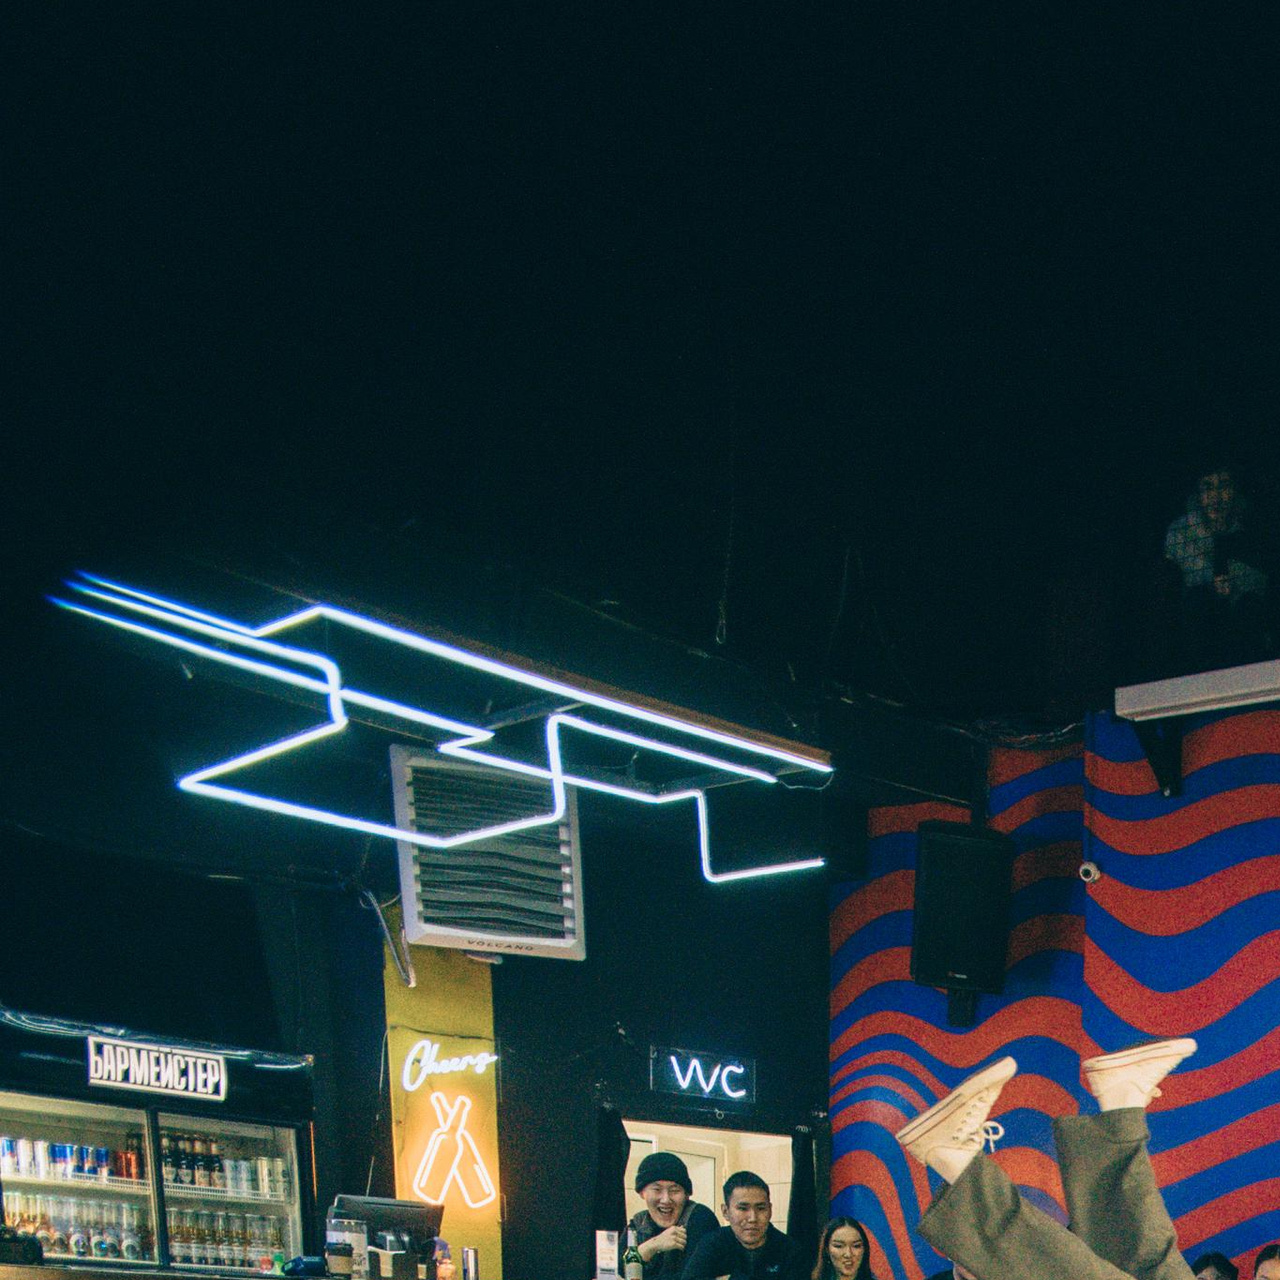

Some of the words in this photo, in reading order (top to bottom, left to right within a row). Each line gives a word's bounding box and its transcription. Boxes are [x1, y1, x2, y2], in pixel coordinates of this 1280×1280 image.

[467, 939, 534, 952] VOLCANO
[90, 1041, 221, 1095] БАРМЕЙСТЕР
[670, 1055, 746, 1098] WC
